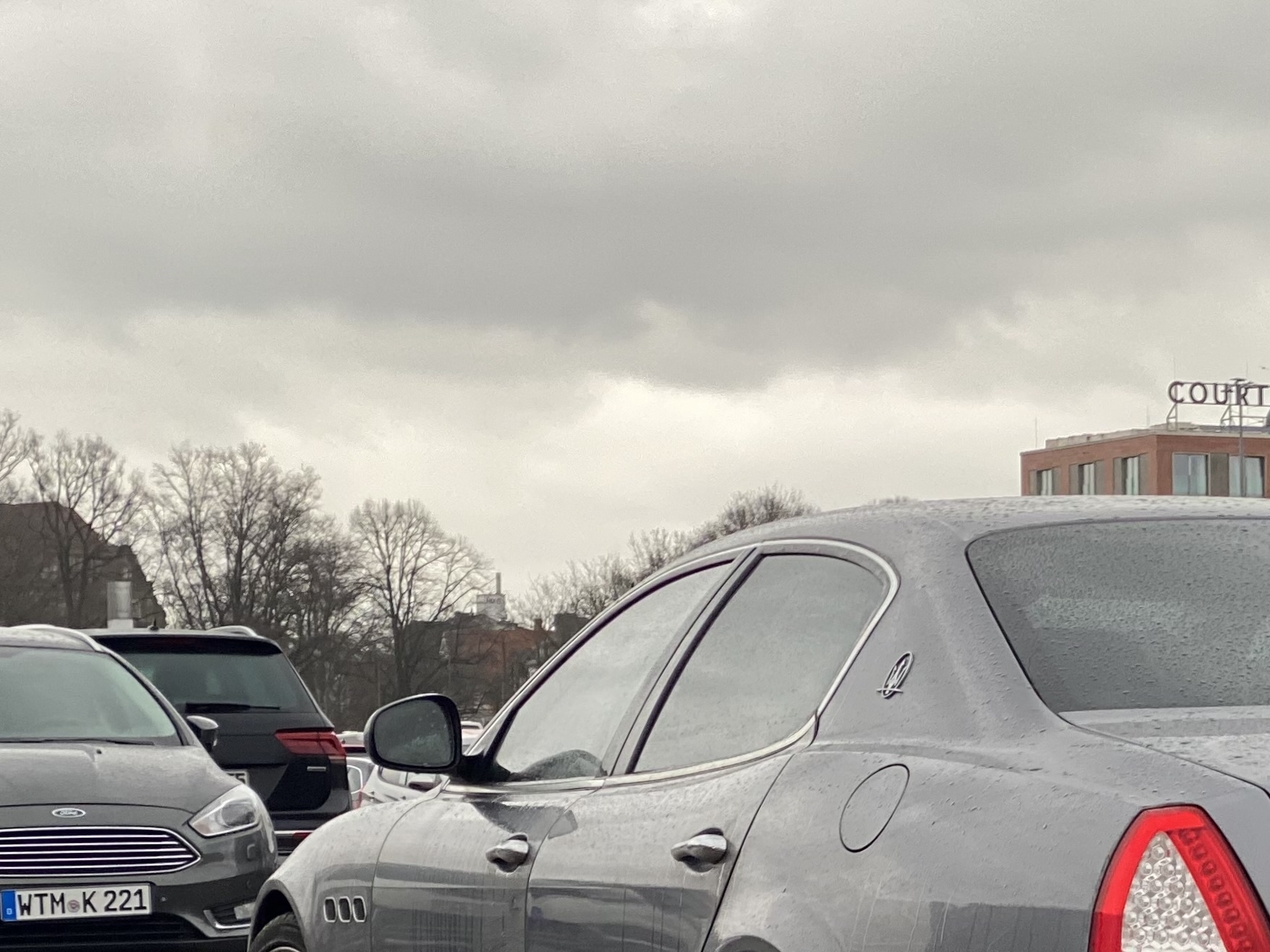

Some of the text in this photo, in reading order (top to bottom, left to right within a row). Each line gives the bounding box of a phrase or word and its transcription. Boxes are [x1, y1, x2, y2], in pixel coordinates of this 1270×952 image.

[17, 892, 66, 916] WTM
[82, 890, 97, 913] K
[104, 888, 147, 912] 221
